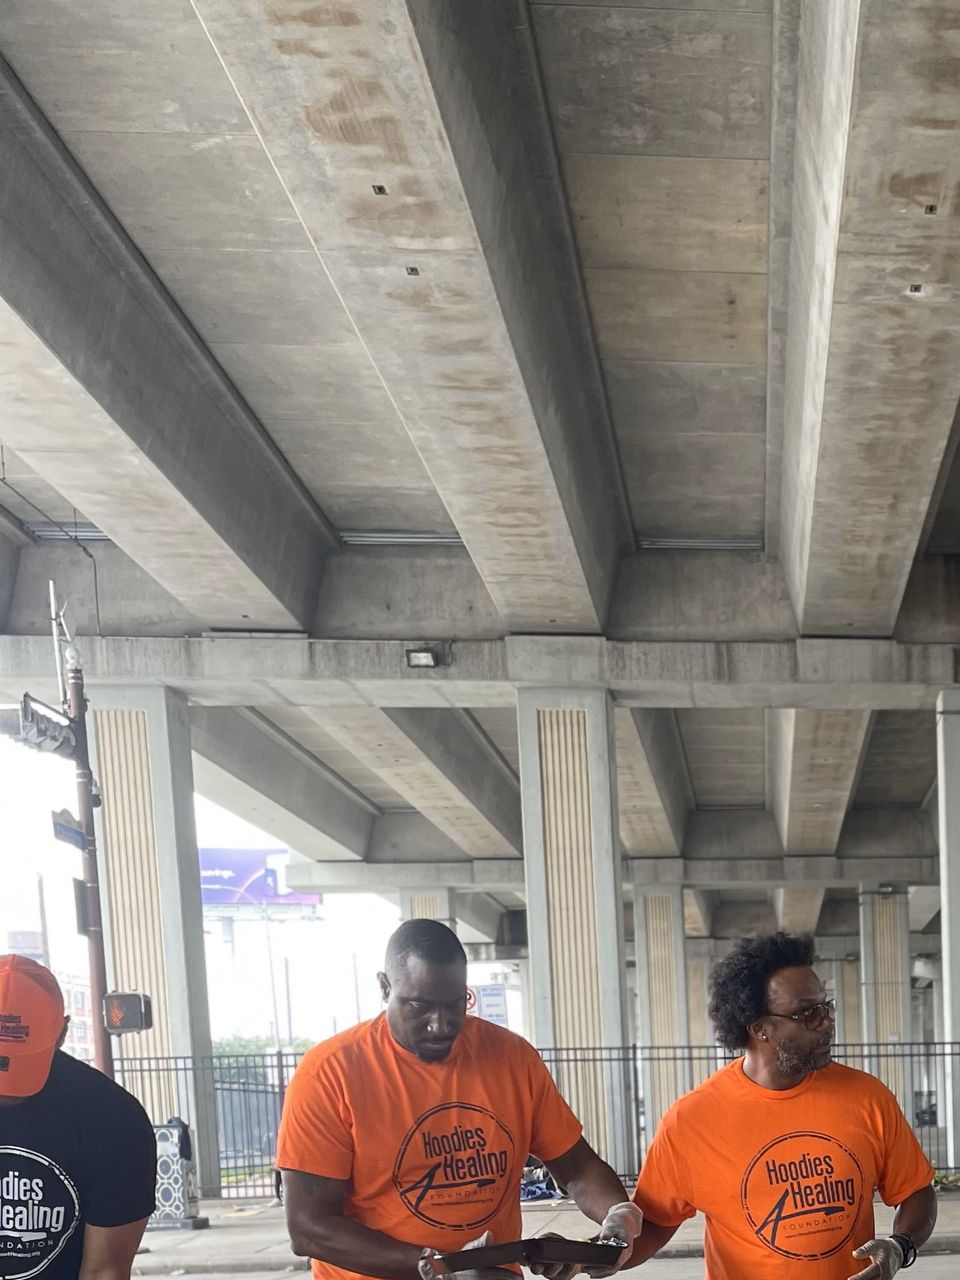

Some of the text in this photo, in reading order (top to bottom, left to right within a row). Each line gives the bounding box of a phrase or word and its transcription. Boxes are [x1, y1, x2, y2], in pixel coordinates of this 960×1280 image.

[422, 1125, 487, 1160] Hoodies
[442, 1149, 508, 1182] Healing
[765, 1152, 835, 1186] Hoodies
[0, 1170, 44, 1201] dies
[788, 1175, 857, 1210] Healing
[0, 1200, 65, 1233] ealing
[782, 1214, 852, 1231] FOUNDATION
